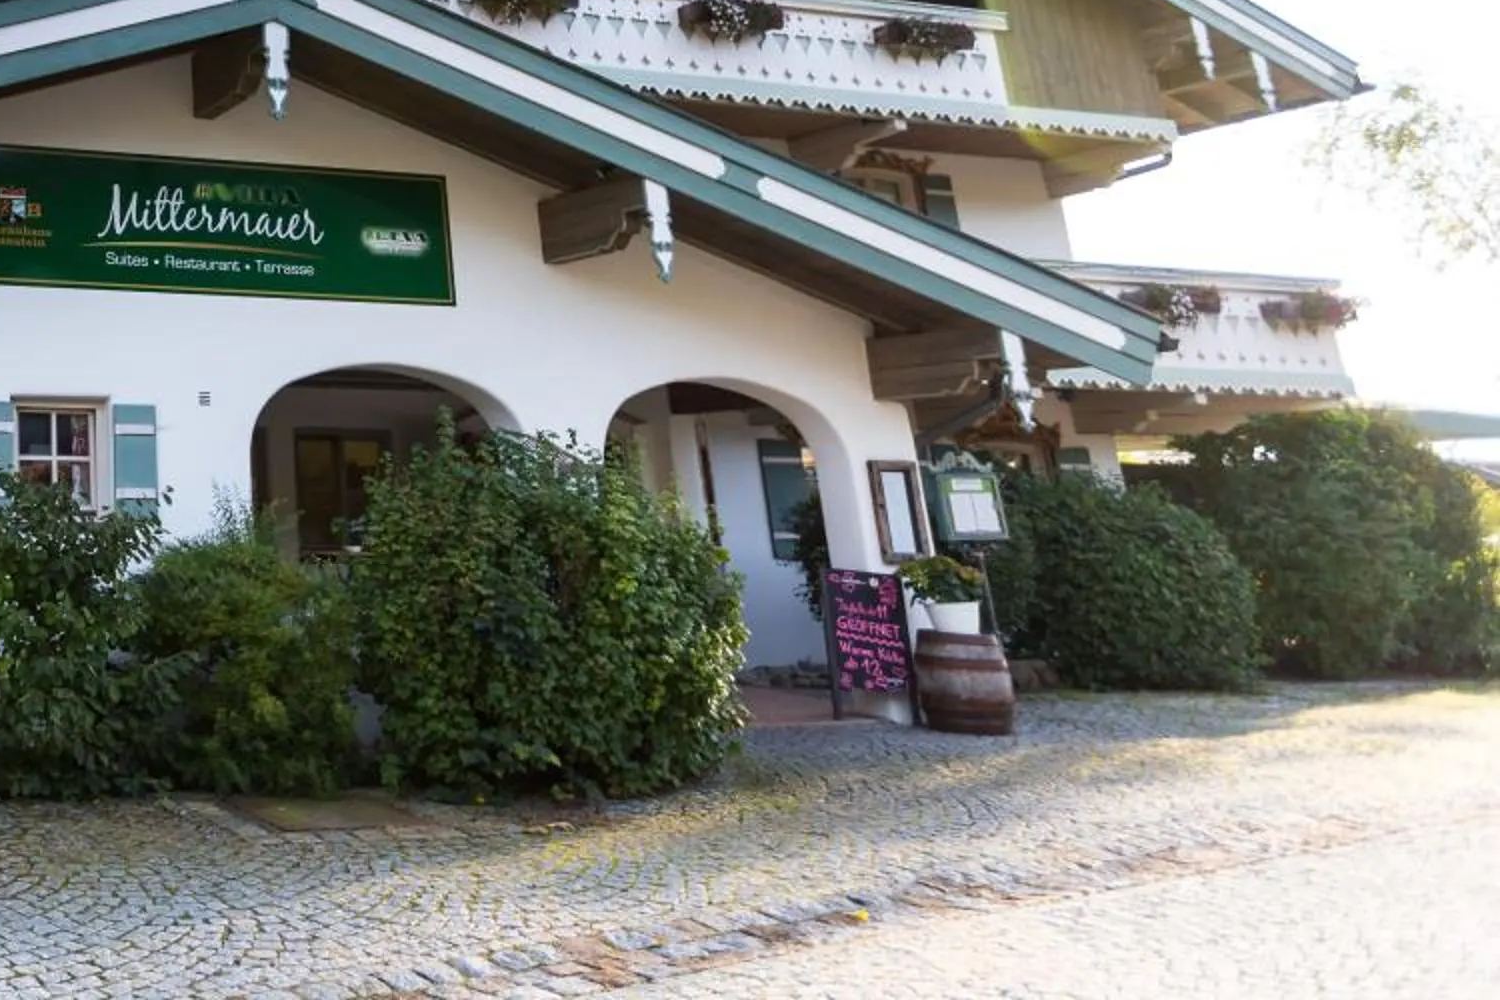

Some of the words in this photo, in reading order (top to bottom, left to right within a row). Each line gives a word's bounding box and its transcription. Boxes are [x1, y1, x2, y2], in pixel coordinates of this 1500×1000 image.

[97, 183, 325, 246] Mittermaier
[104, 251, 150, 268] Suites
[164, 253, 243, 273] Restaurant
[256, 259, 316, 277] Terrasse
